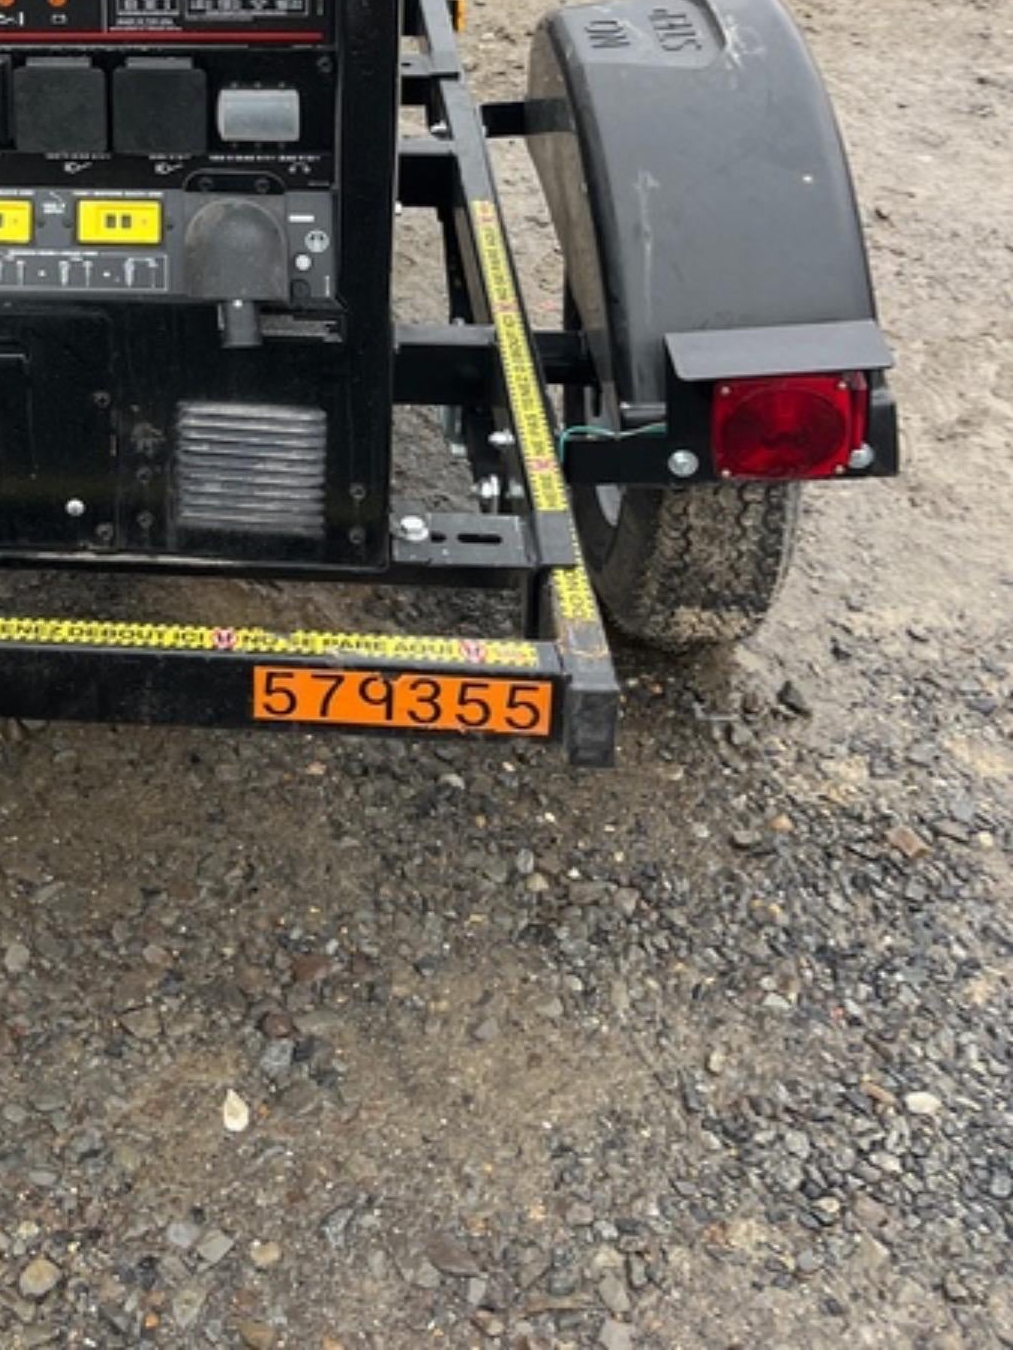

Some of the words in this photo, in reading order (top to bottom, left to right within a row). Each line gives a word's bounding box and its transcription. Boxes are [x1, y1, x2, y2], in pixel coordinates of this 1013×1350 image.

[584, 19, 631, 50] NO
[648, 8, 703, 52] STEP
[263, 671, 542, 731] 579355
